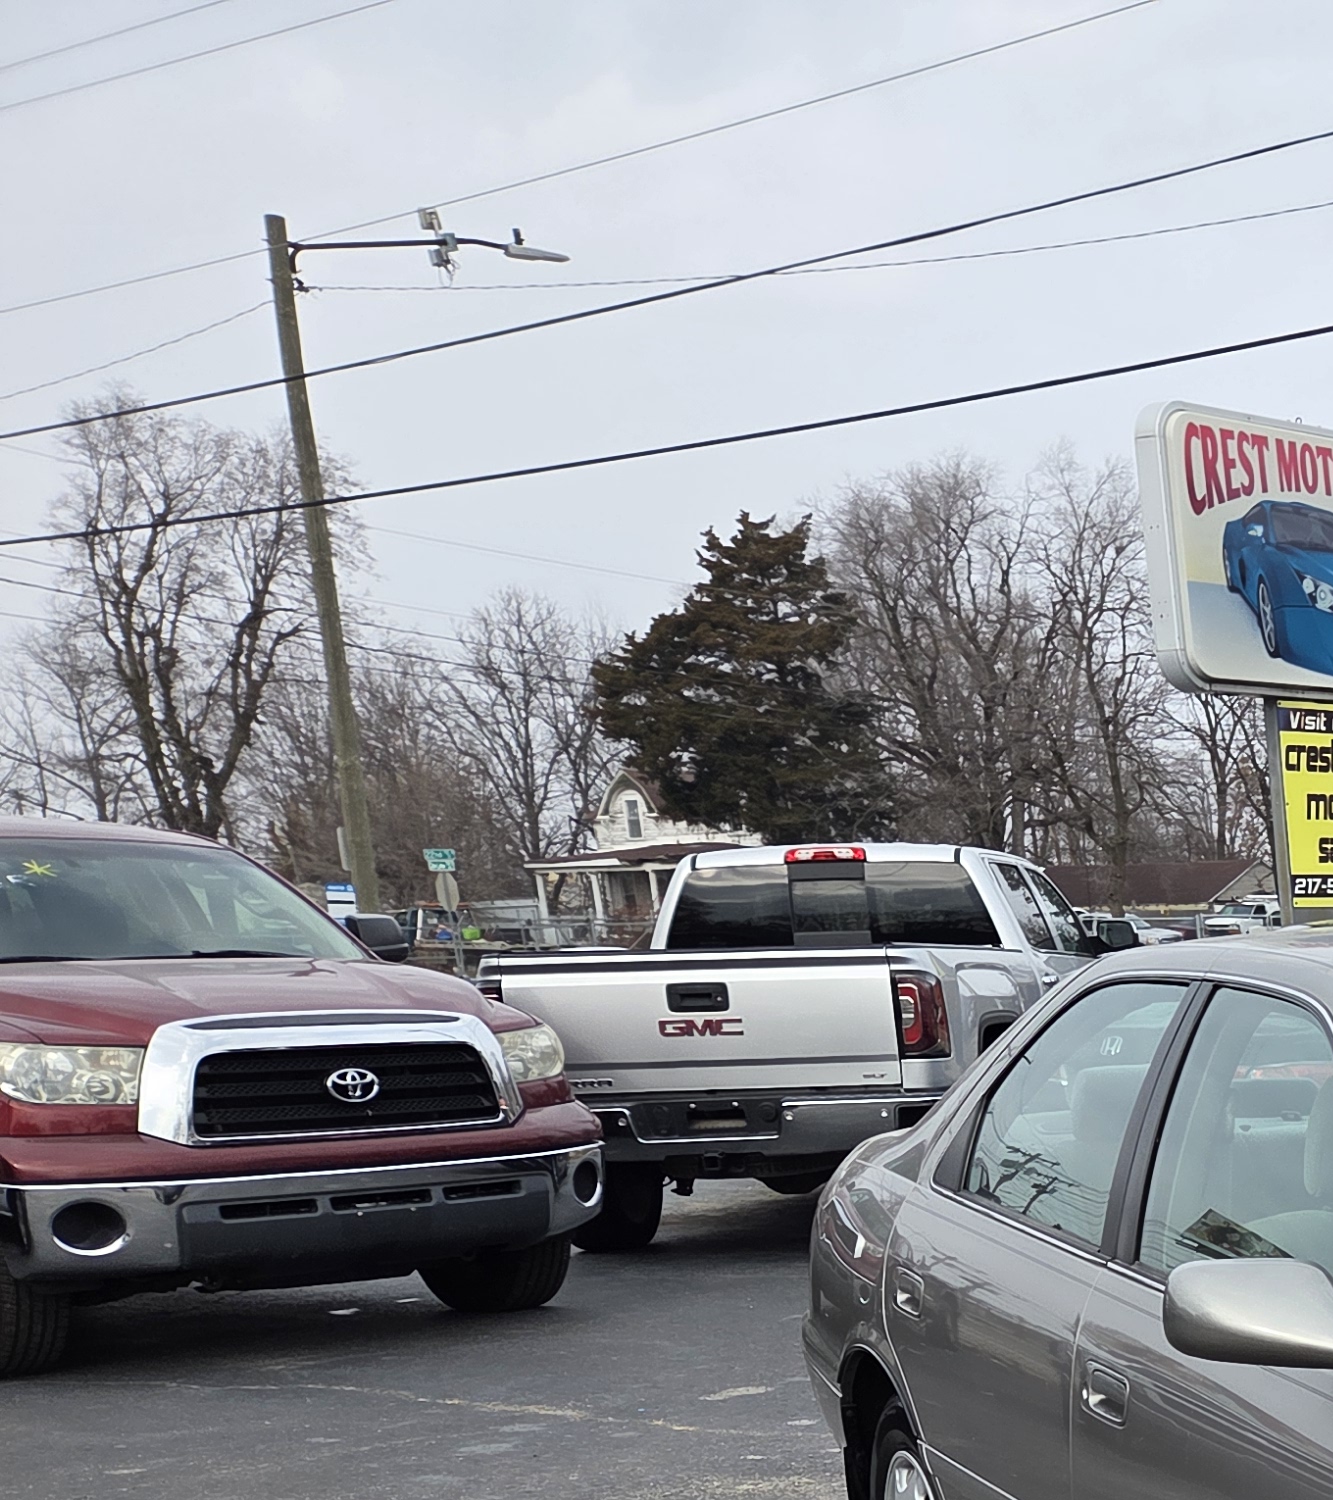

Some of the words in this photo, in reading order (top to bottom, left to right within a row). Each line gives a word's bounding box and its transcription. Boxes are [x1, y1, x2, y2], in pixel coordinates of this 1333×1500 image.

[1185, 421, 1269, 516] CREST
[1289, 711, 1328, 732] Visit
[658, 1018, 744, 1037] GMC
